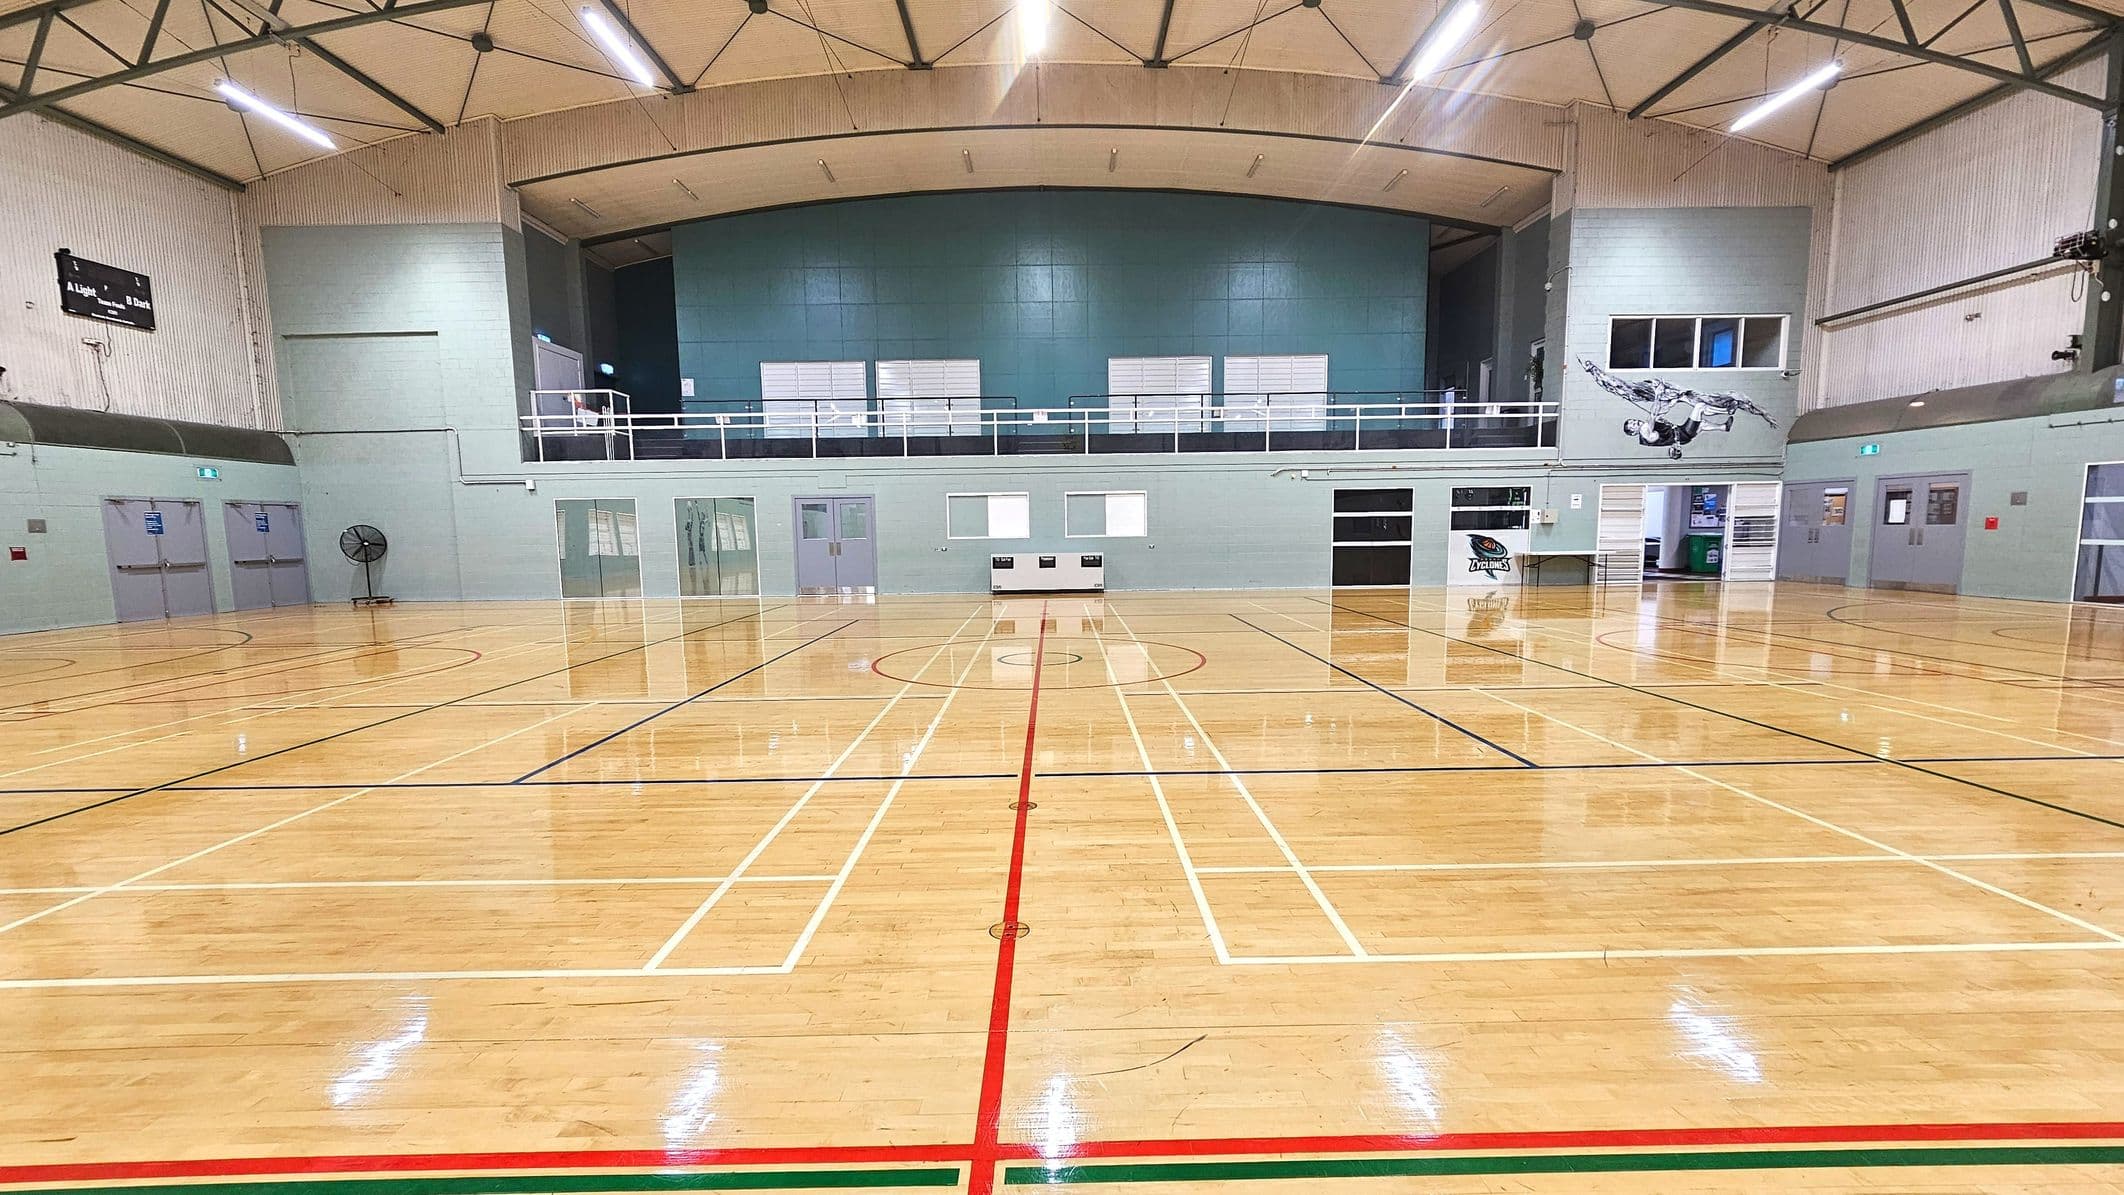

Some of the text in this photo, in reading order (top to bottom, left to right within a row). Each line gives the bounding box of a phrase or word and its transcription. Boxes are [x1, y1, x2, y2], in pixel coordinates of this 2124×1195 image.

[67, 281, 97, 298] A Light
[126, 295, 151, 310] B Dark
[1470, 559, 1509, 571] CYCLONES
